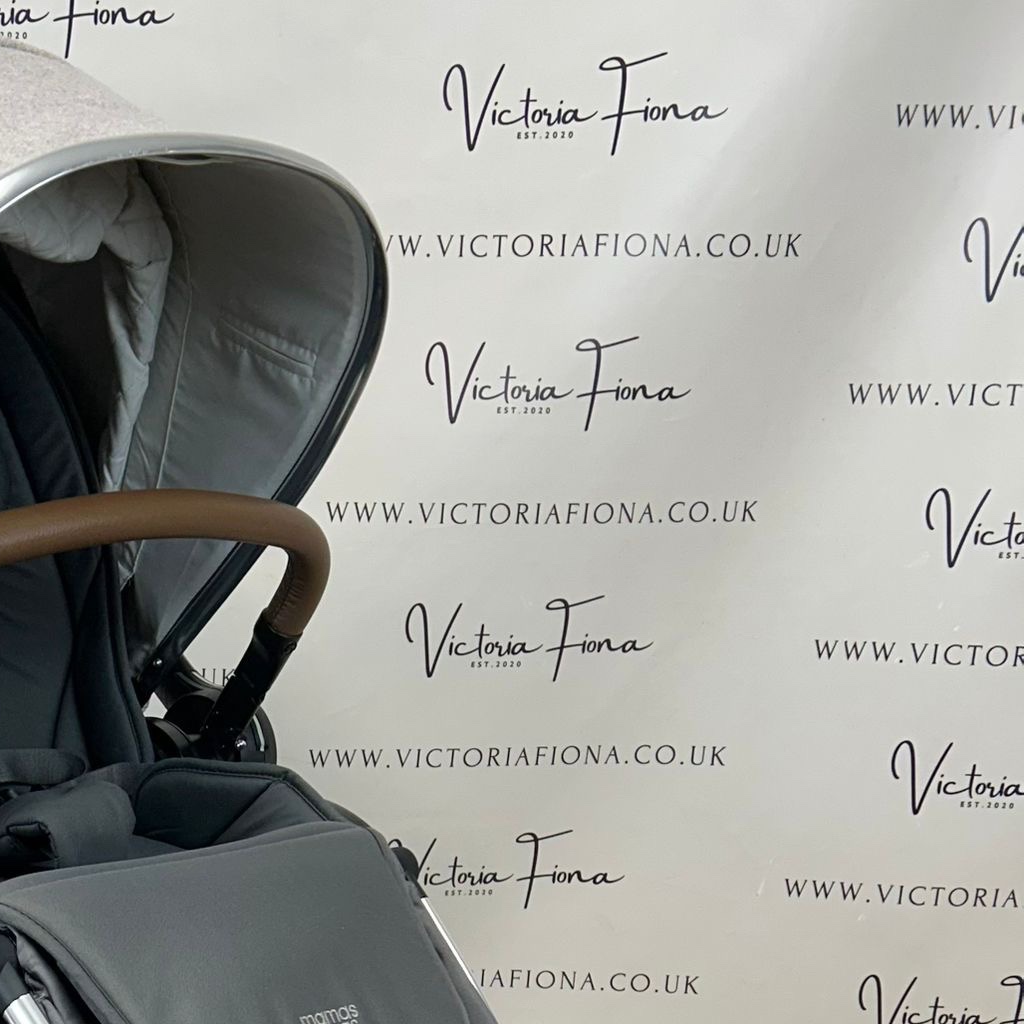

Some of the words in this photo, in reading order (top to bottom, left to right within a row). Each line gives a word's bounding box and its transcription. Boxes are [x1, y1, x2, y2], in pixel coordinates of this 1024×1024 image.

[443, 64, 598, 151] Victoria
[599, 53, 728, 156] Fiona
[516, 131, 574, 139] EST.2020
[385, 233, 802, 258] W.VICTORIAFIONA.CO.UK
[425, 342, 574, 424] Victoria
[576, 337, 691, 431] Fiona
[326, 500, 758, 525] WWW.VICTORIAFIONA.CO.UK
[405, 603, 544, 678] Victoria
[546, 596, 654, 682] Fiona
[309, 745, 727, 768] WWW.VICTORIAFIONA.CO.UK
[891, 740, 1024, 815] Victoria
[960, 801, 1015, 809] EST.2020
[515, 830, 625, 908] Fiona
[784, 878, 1024, 908] WWW.VICTORIA
